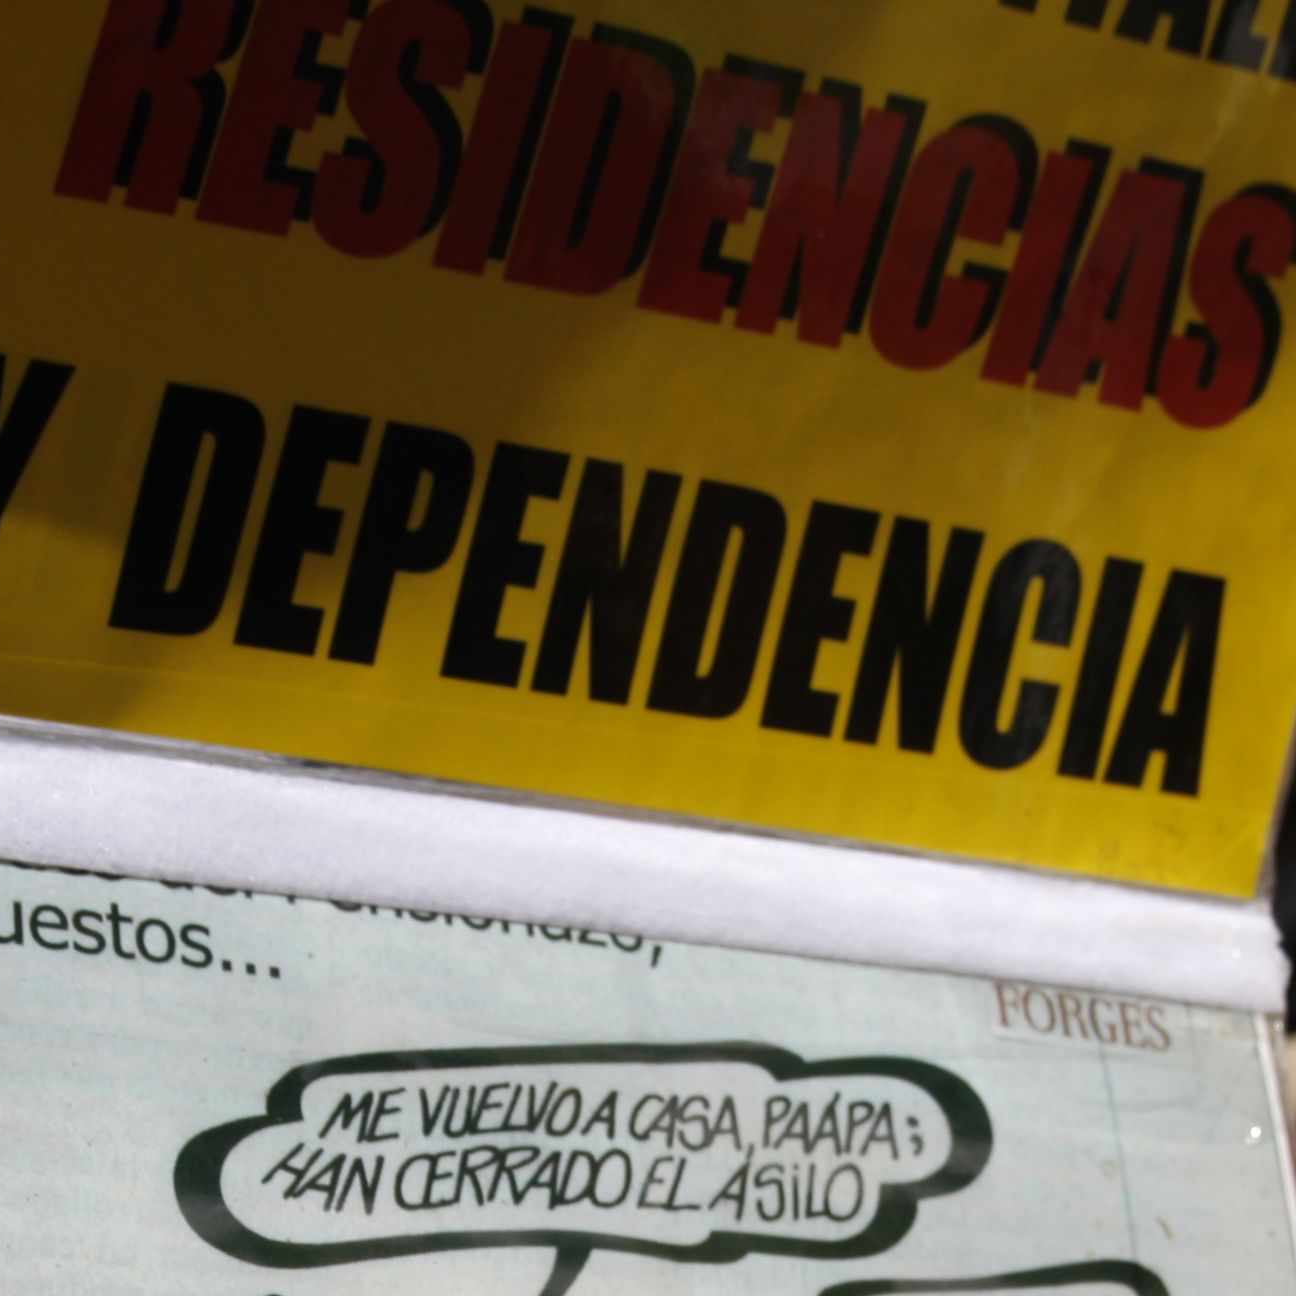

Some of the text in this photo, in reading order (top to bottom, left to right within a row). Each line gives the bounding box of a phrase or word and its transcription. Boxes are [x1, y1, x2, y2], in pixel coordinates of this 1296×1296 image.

[107, 381, 1227, 799] DEPENDENCIA
[992, 979, 1172, 1053] FORGES
[317, 1087, 407, 1143] ME
[418, 1081, 583, 1139] VUELVO
[581, 1089, 619, 1140] A
[260, 1142, 385, 1216] HAN
[394, 1145, 633, 1211] CERRADO
[636, 1155, 701, 1212] EL
